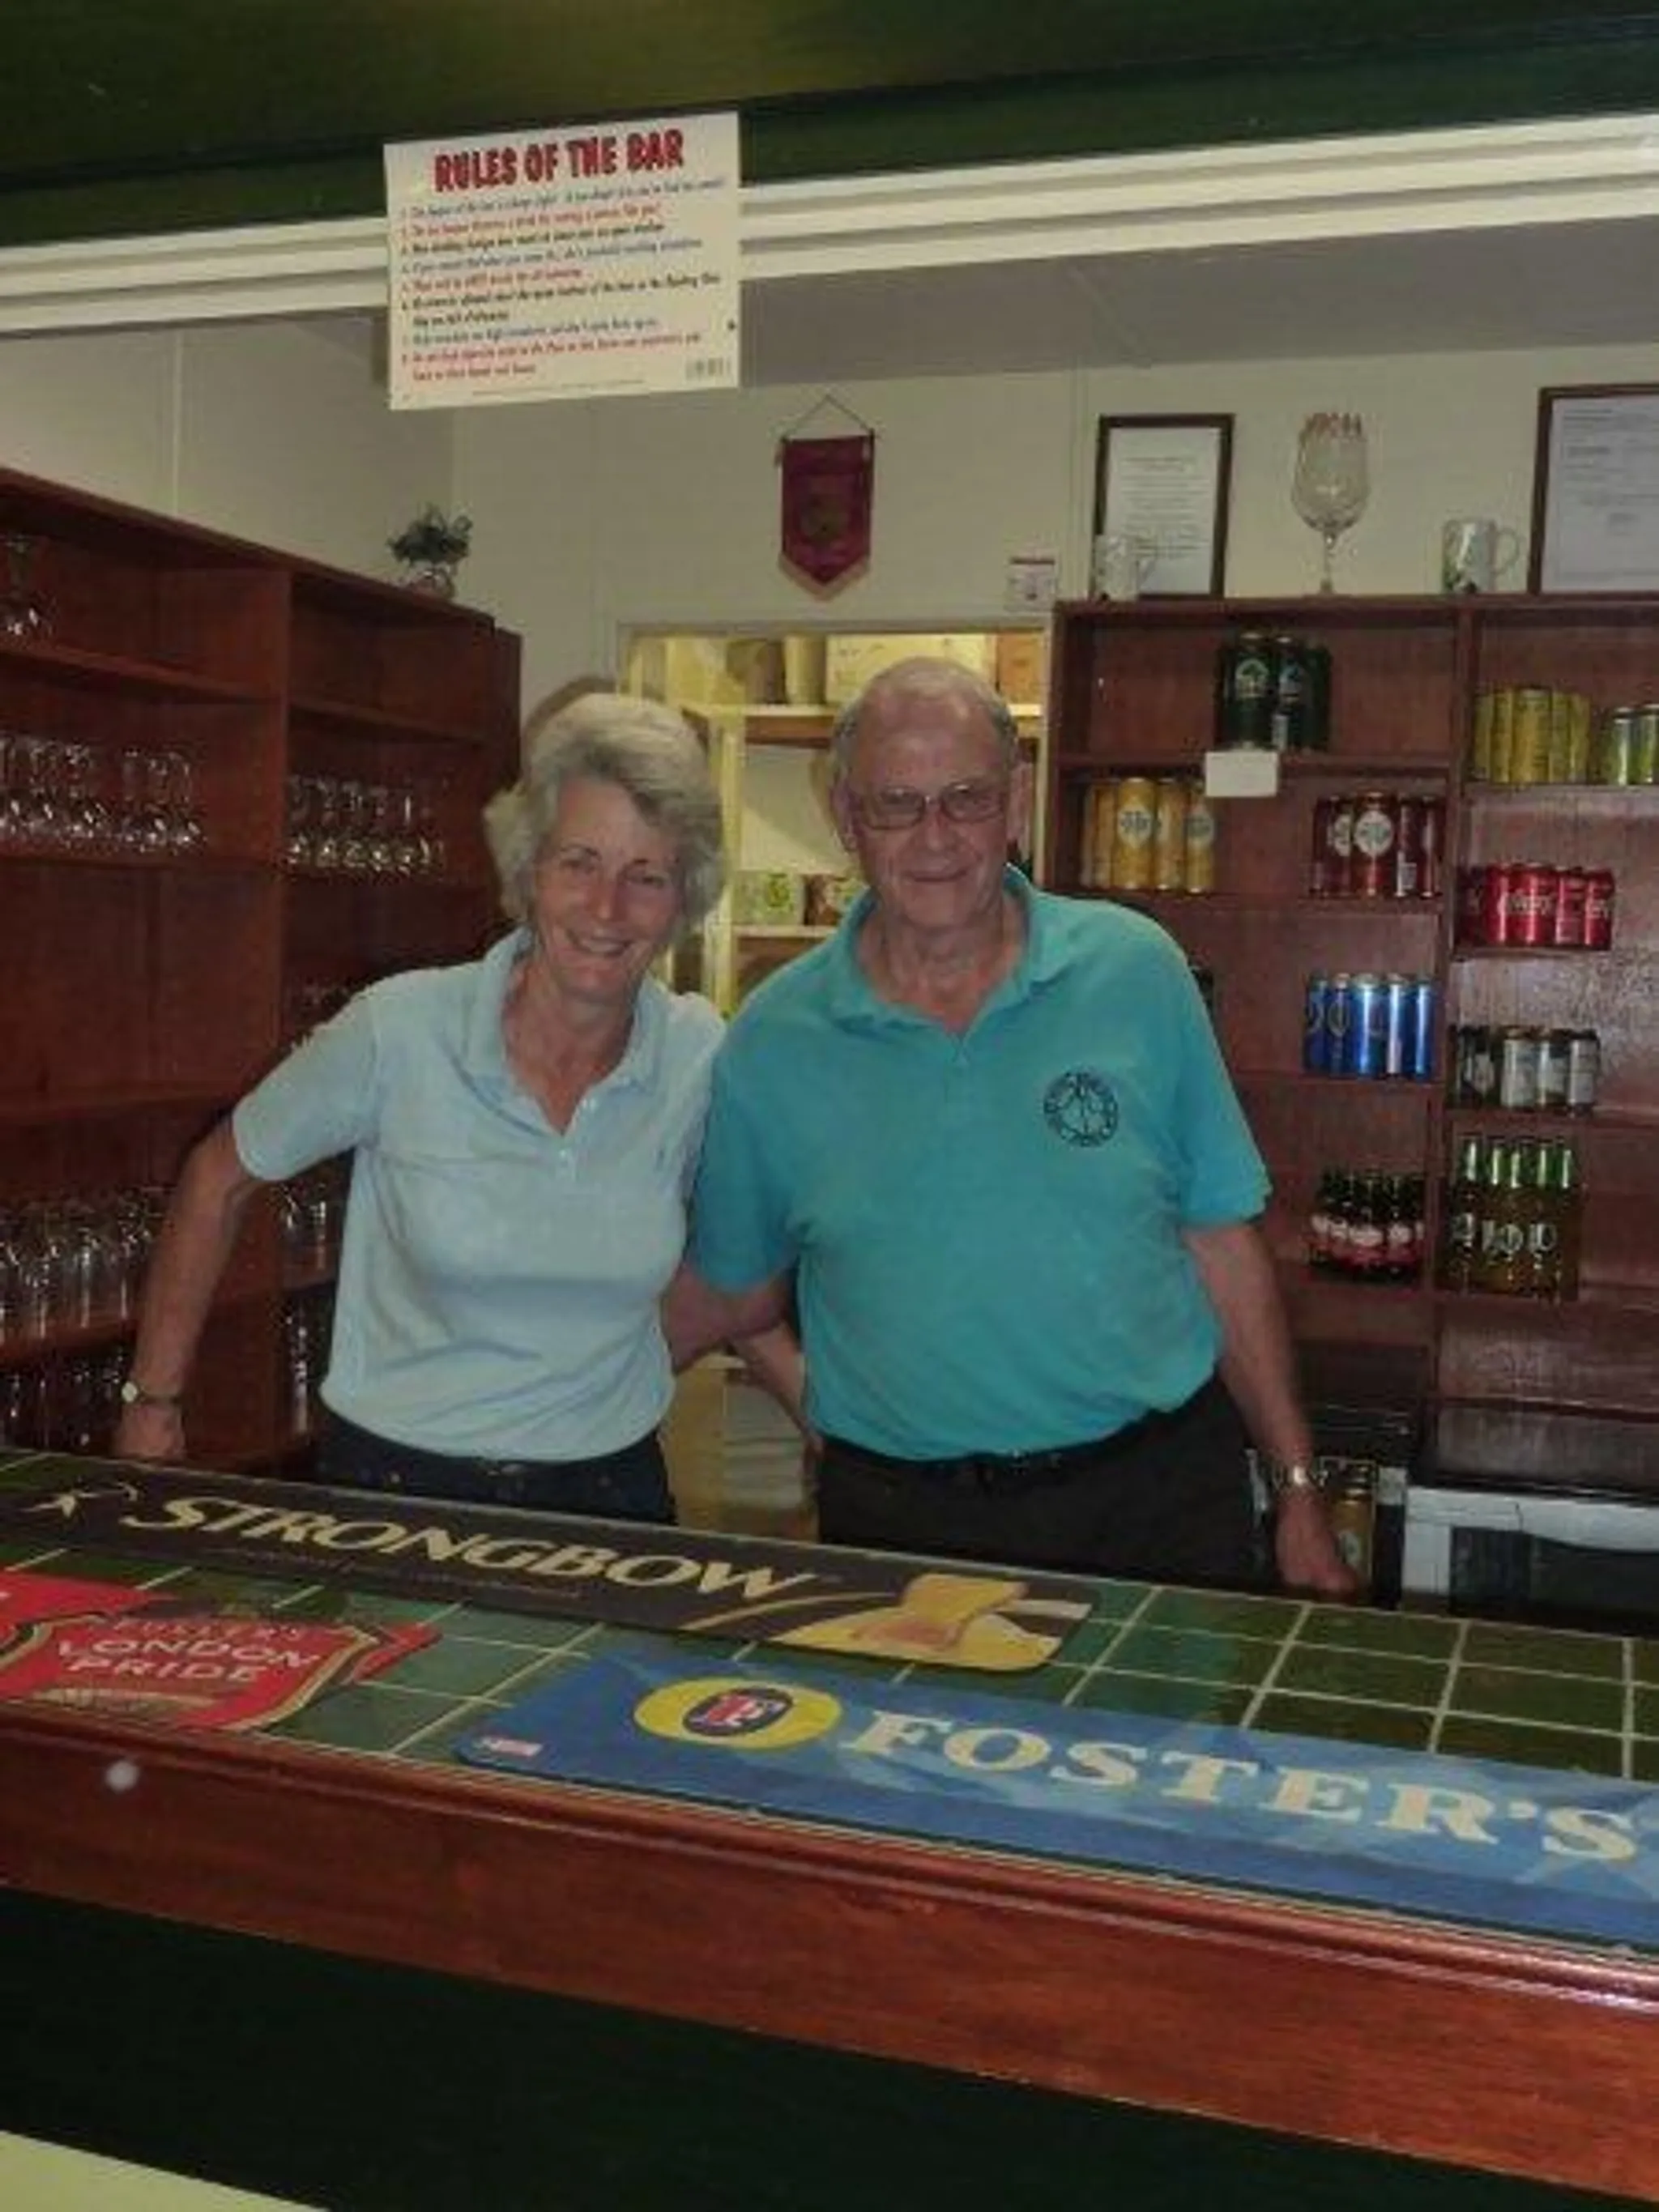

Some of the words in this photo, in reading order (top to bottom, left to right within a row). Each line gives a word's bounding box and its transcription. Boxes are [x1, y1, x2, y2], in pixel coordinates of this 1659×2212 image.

[435, 147, 517, 193] RULES
[524, 143, 558, 183] OF
[566, 136, 617, 178] THE
[626, 129, 684, 173] BAR
[122, 1495, 820, 1600] STRONGBOW
[58, 1639, 321, 1669] LONDON
[66, 1657, 268, 1683] PRIDE
[840, 1709, 1636, 1861] FOSTER'S
